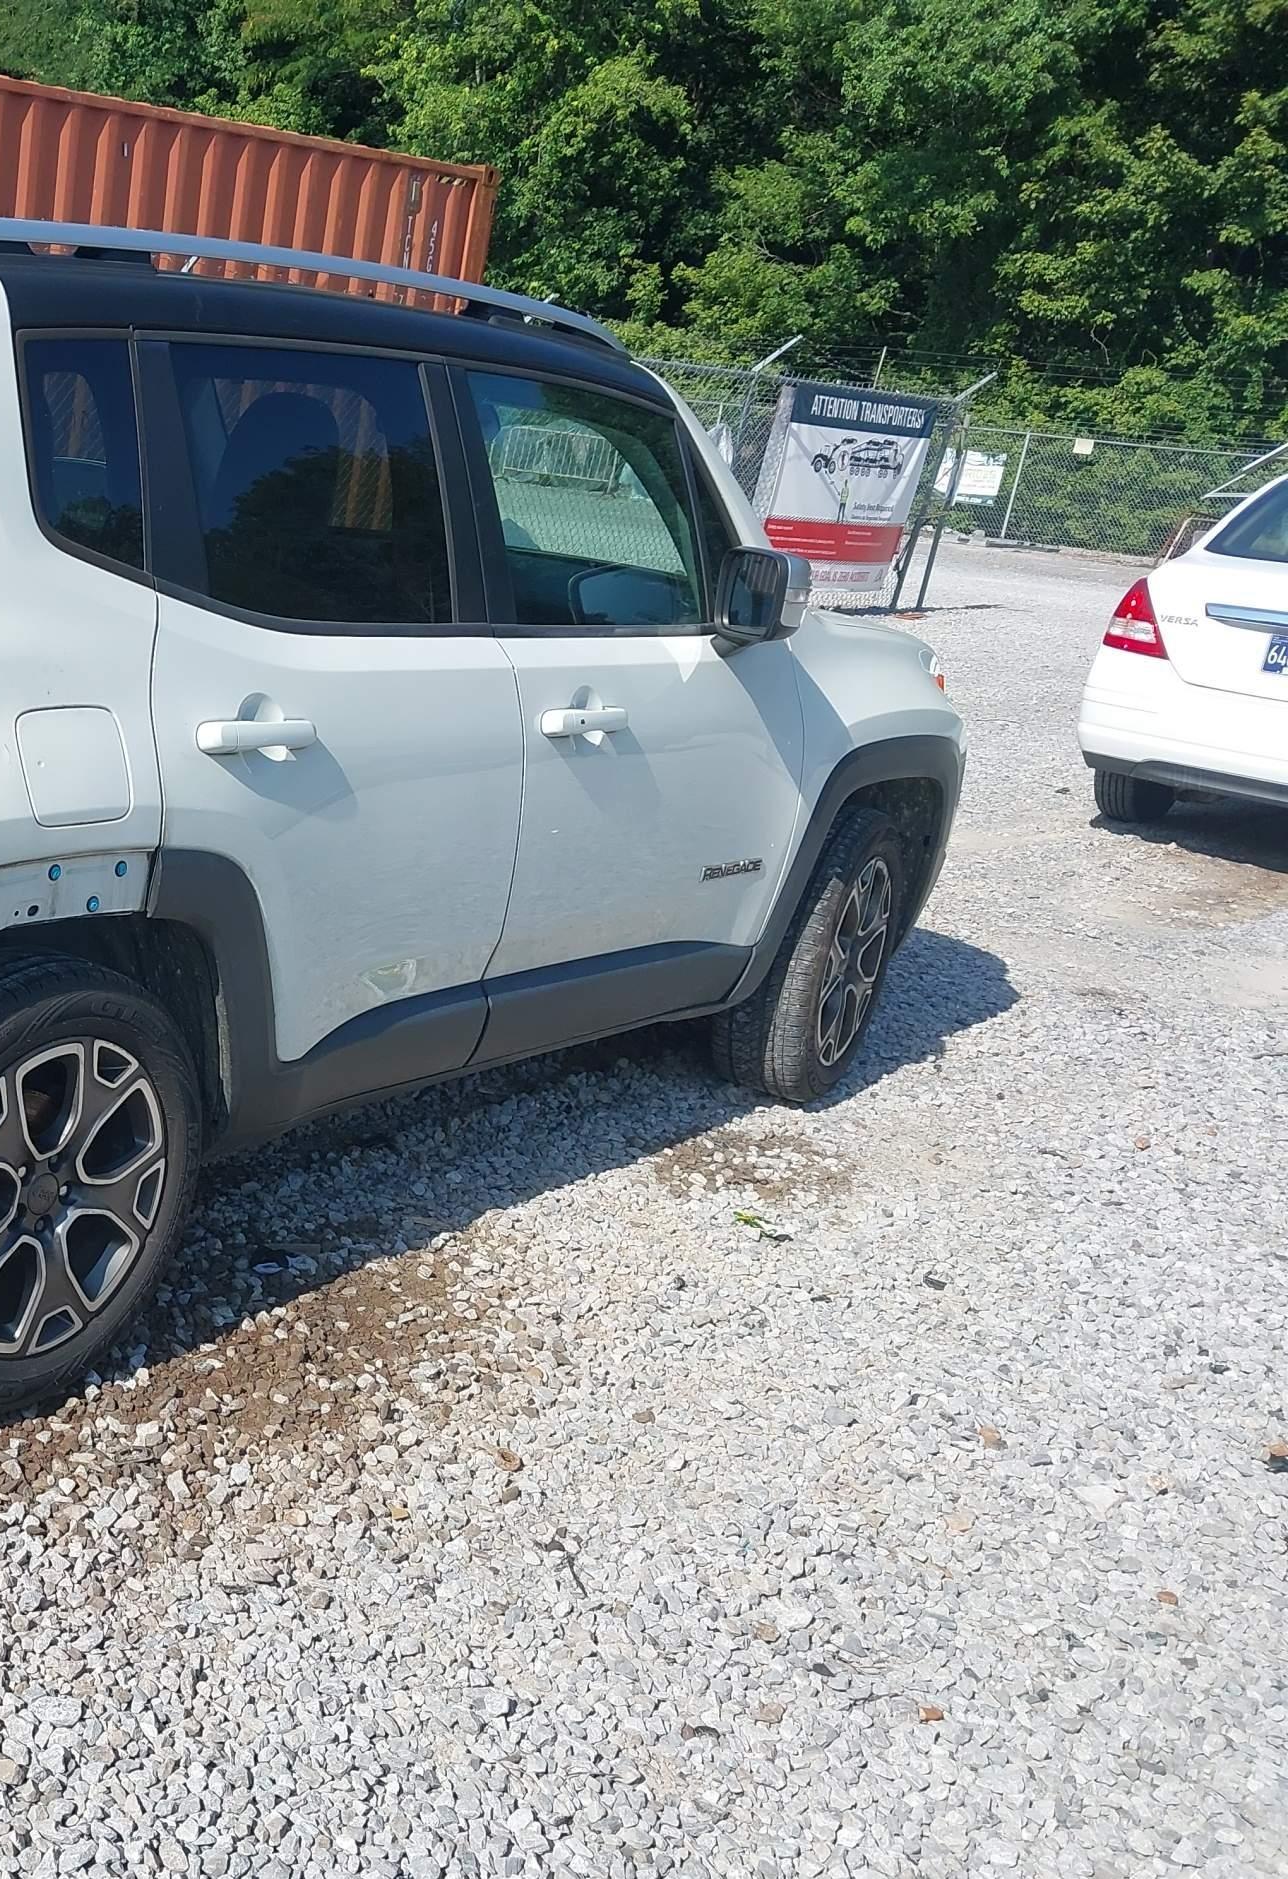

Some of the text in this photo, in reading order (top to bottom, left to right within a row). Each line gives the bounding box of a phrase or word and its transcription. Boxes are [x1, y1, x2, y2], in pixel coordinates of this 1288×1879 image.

[402, 216, 413, 270] TCN
[426, 220, 438, 272] 45G
[811, 394, 860, 420] ATTENTION
[1160, 614, 1199, 627] VERSA
[1267, 644, 1288, 667] 64
[699, 857, 763, 882] RENEGADE
